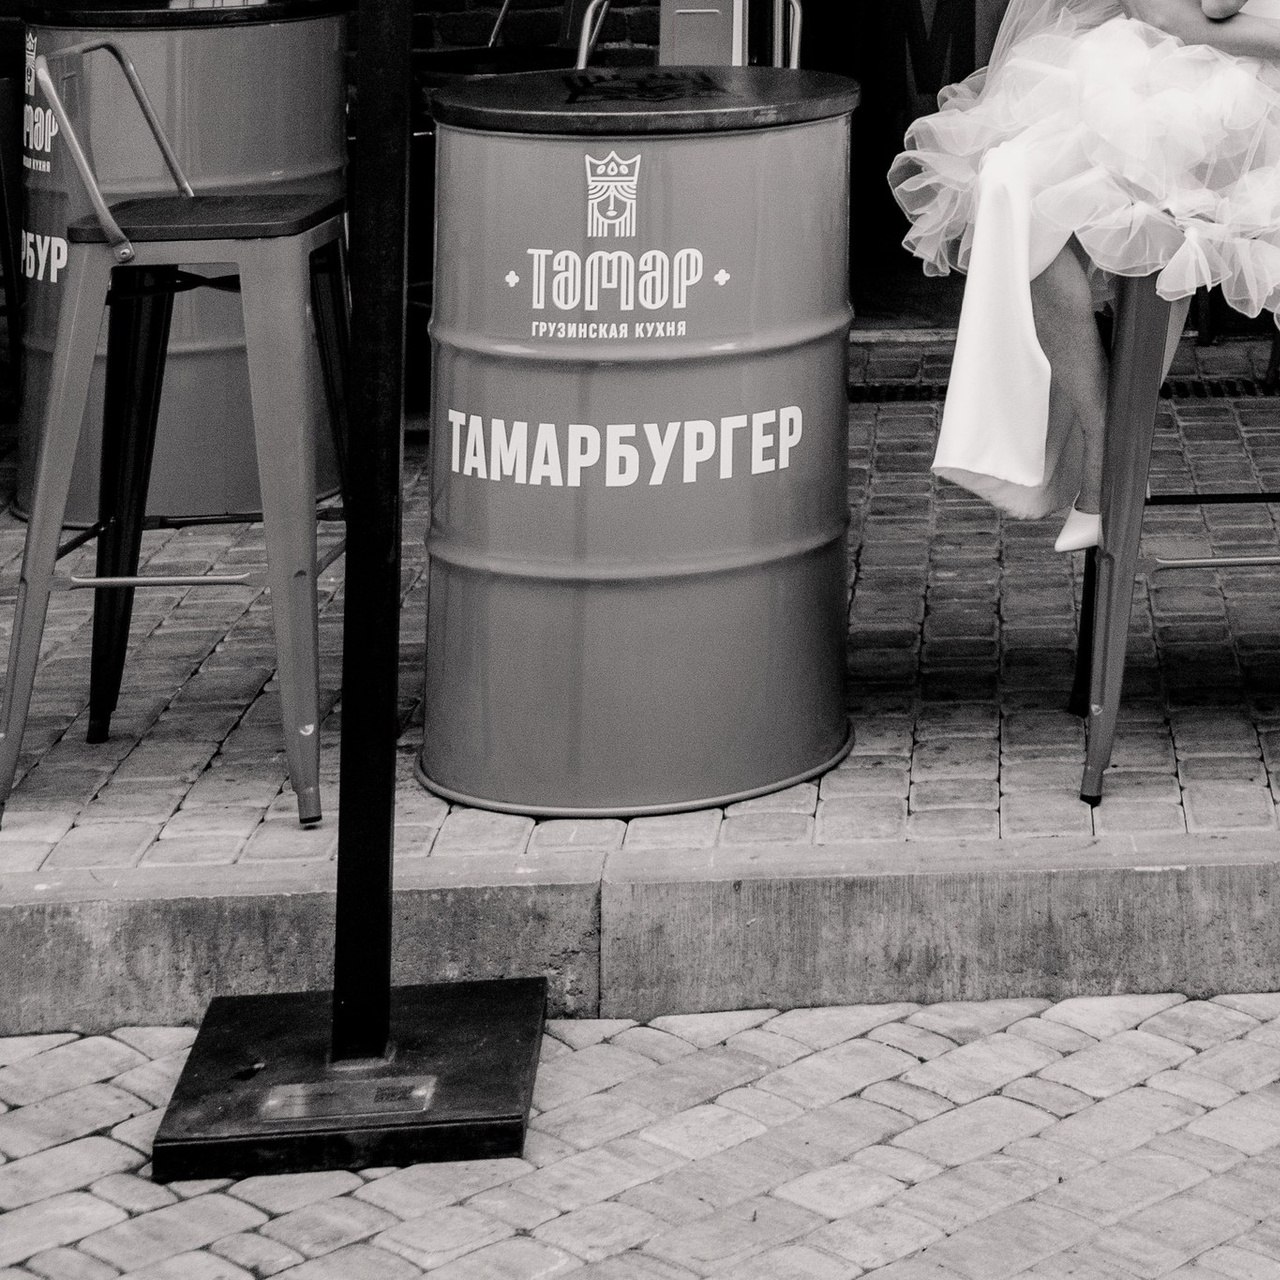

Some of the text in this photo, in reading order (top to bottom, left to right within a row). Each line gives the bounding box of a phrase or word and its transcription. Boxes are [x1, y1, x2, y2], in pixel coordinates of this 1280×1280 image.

[531, 320, 687, 339] ГРУЗИНСКАЯ КУХНЯ
[448, 405, 803, 488] ТАМАРБУРГЕР
